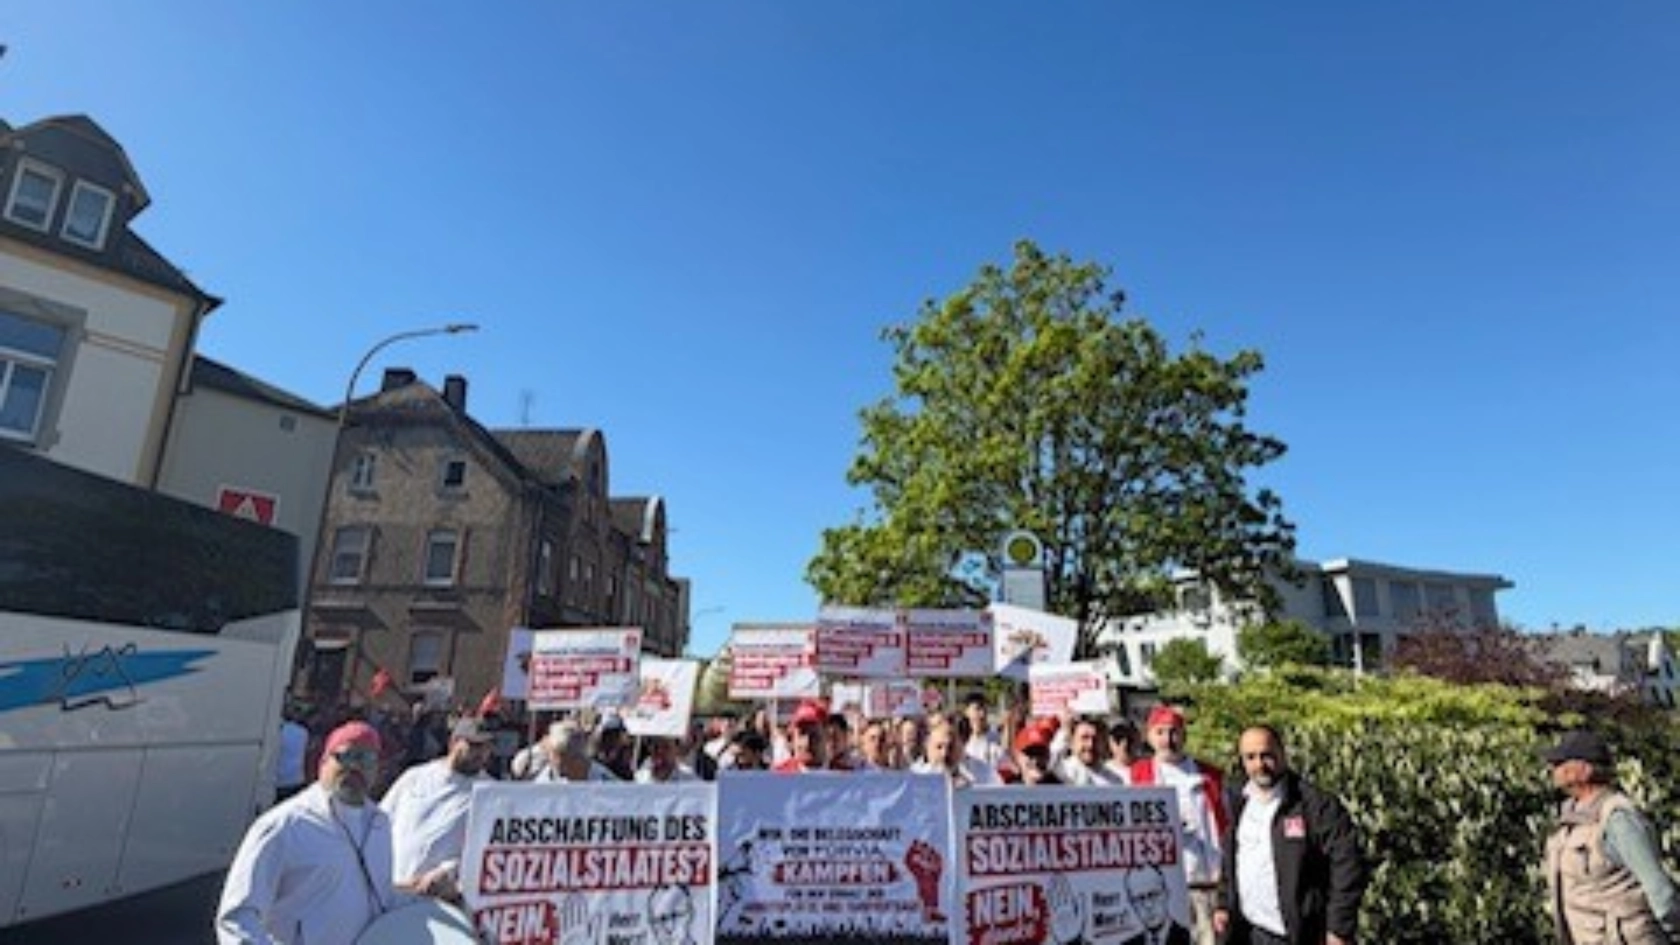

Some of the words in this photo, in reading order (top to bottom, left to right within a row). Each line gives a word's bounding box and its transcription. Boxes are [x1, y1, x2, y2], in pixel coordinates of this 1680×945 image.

[490, 817, 659, 844] ABSCHAFFUNG
[664, 814, 708, 840] DES
[969, 801, 1125, 829] ABSCHAFFUNG
[1130, 800, 1169, 823] DES
[484, 846, 709, 891] SOZIALSTAATES?
[971, 830, 1175, 874] SOZIALSTAATES?
[973, 884, 1041, 929] NEIN,
